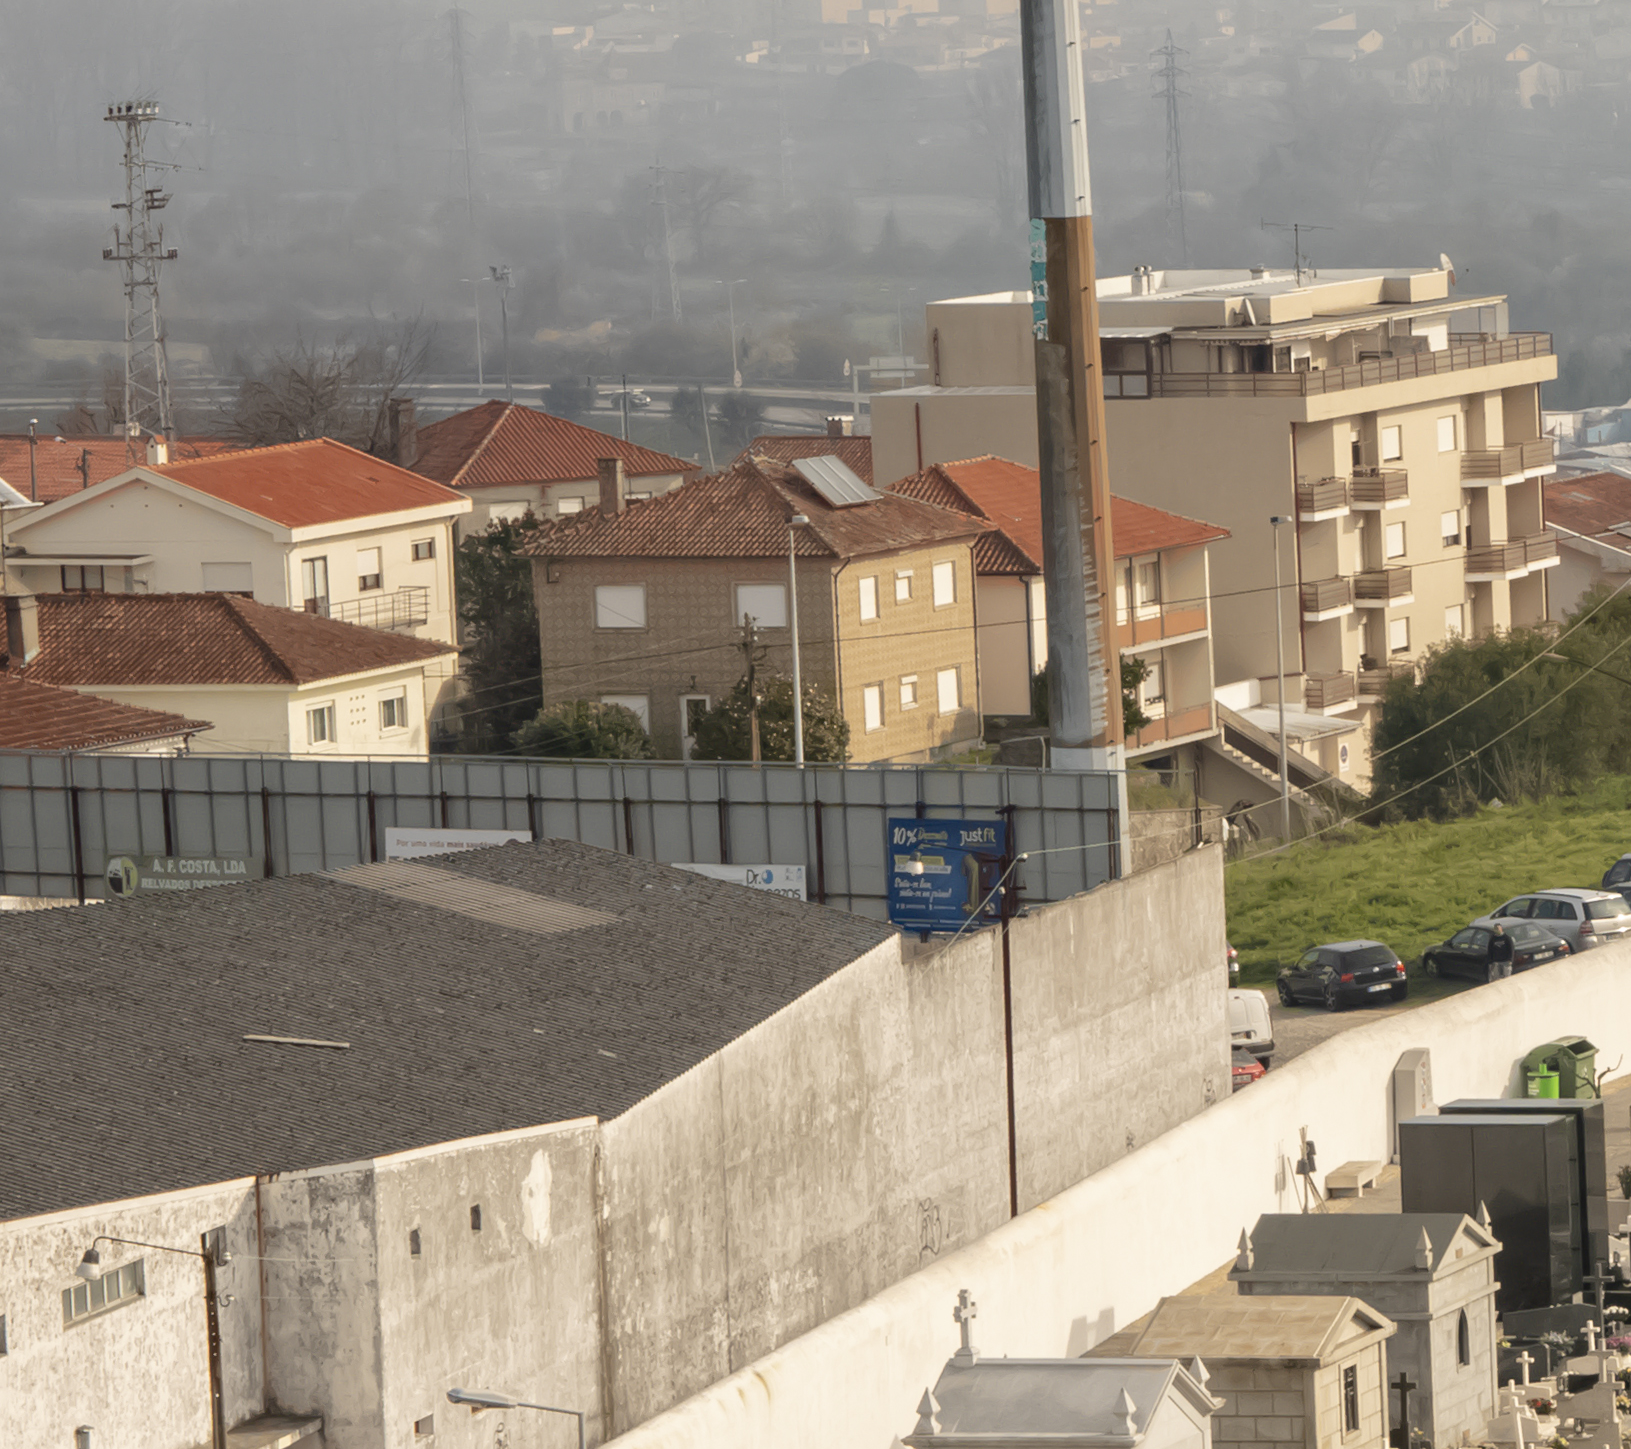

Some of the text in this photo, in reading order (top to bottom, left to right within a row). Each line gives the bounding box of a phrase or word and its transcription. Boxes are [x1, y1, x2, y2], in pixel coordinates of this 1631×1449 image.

[893, 826, 918, 847] 10%
[153, 858, 165, 873] A.
[224, 860, 247, 875] LDA
[746, 868, 761, 885] Dr.
